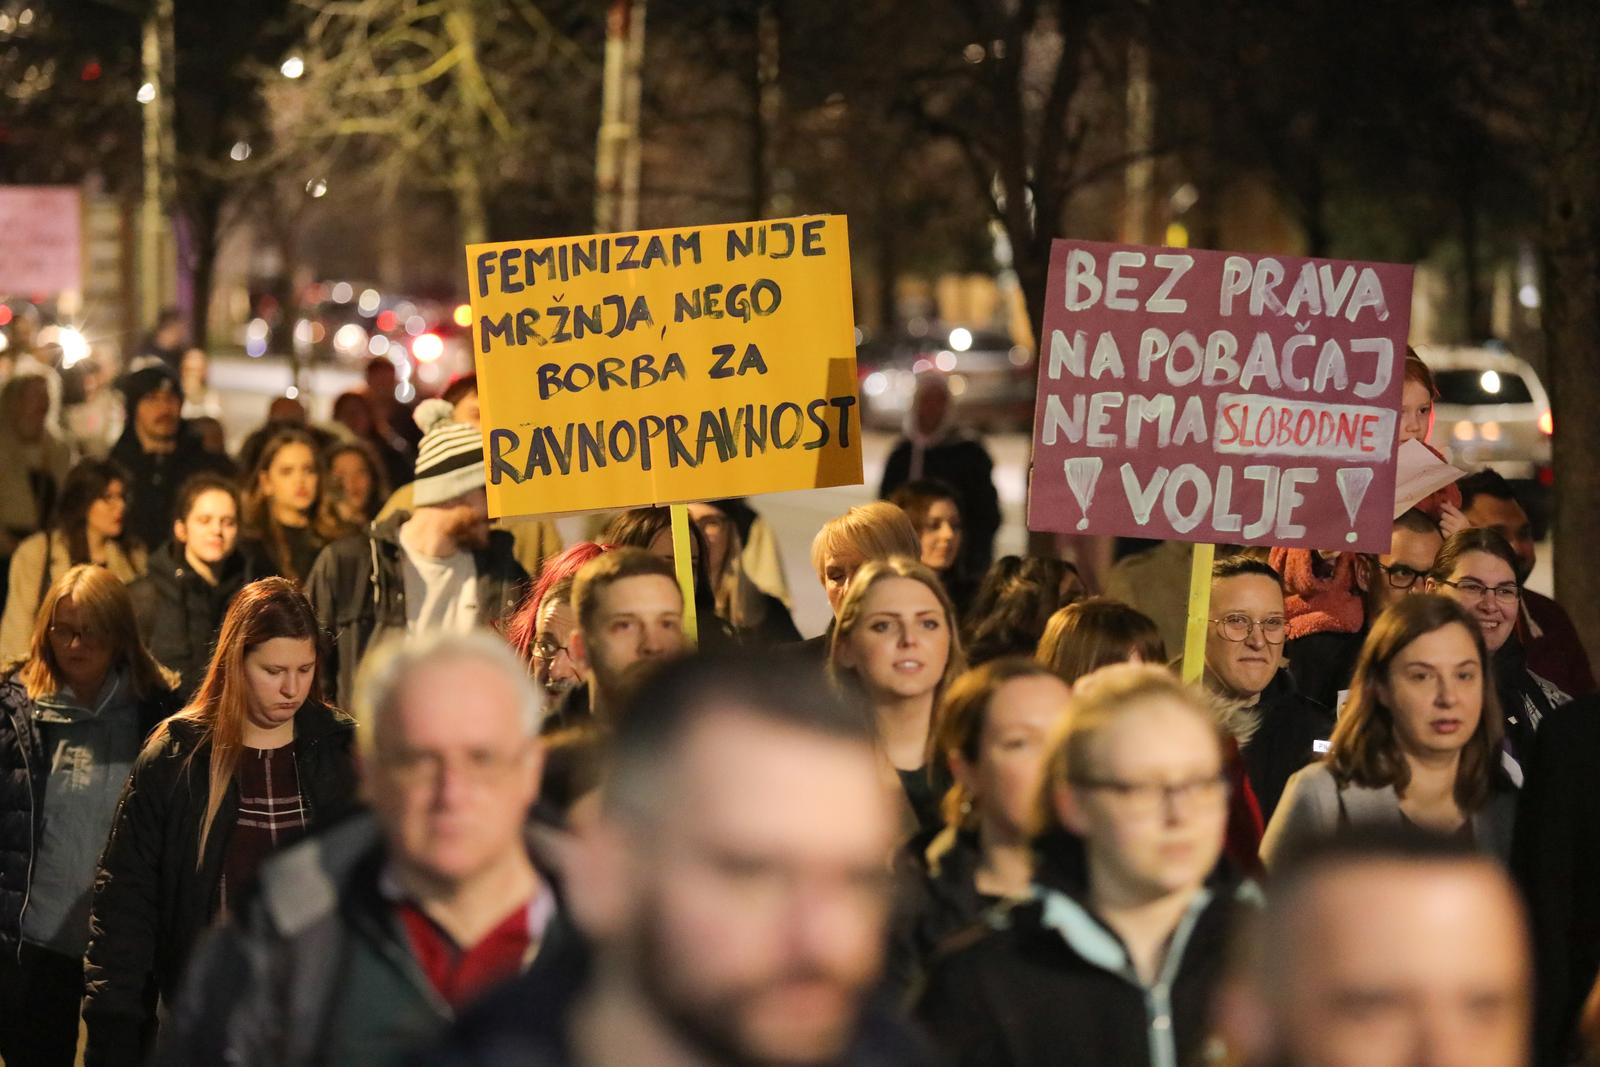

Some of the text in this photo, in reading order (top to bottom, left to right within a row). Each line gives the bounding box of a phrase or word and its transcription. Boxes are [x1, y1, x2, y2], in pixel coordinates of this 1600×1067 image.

[477, 220, 826, 297] FEMINIZAM NIJE
[1065, 249, 1390, 322] BEZ PRAVA
[480, 279, 782, 353] MRŽNJA, NEGO
[537, 343, 768, 400] BORBA ZA
[1048, 320, 1394, 398] NA POBAČAJ
[489, 395, 856, 485] RAVNOPRAVNOST
[1042, 392, 1381, 452] NEMA SLOBODNE
[1064, 457, 1373, 542] ! VOLJE !
